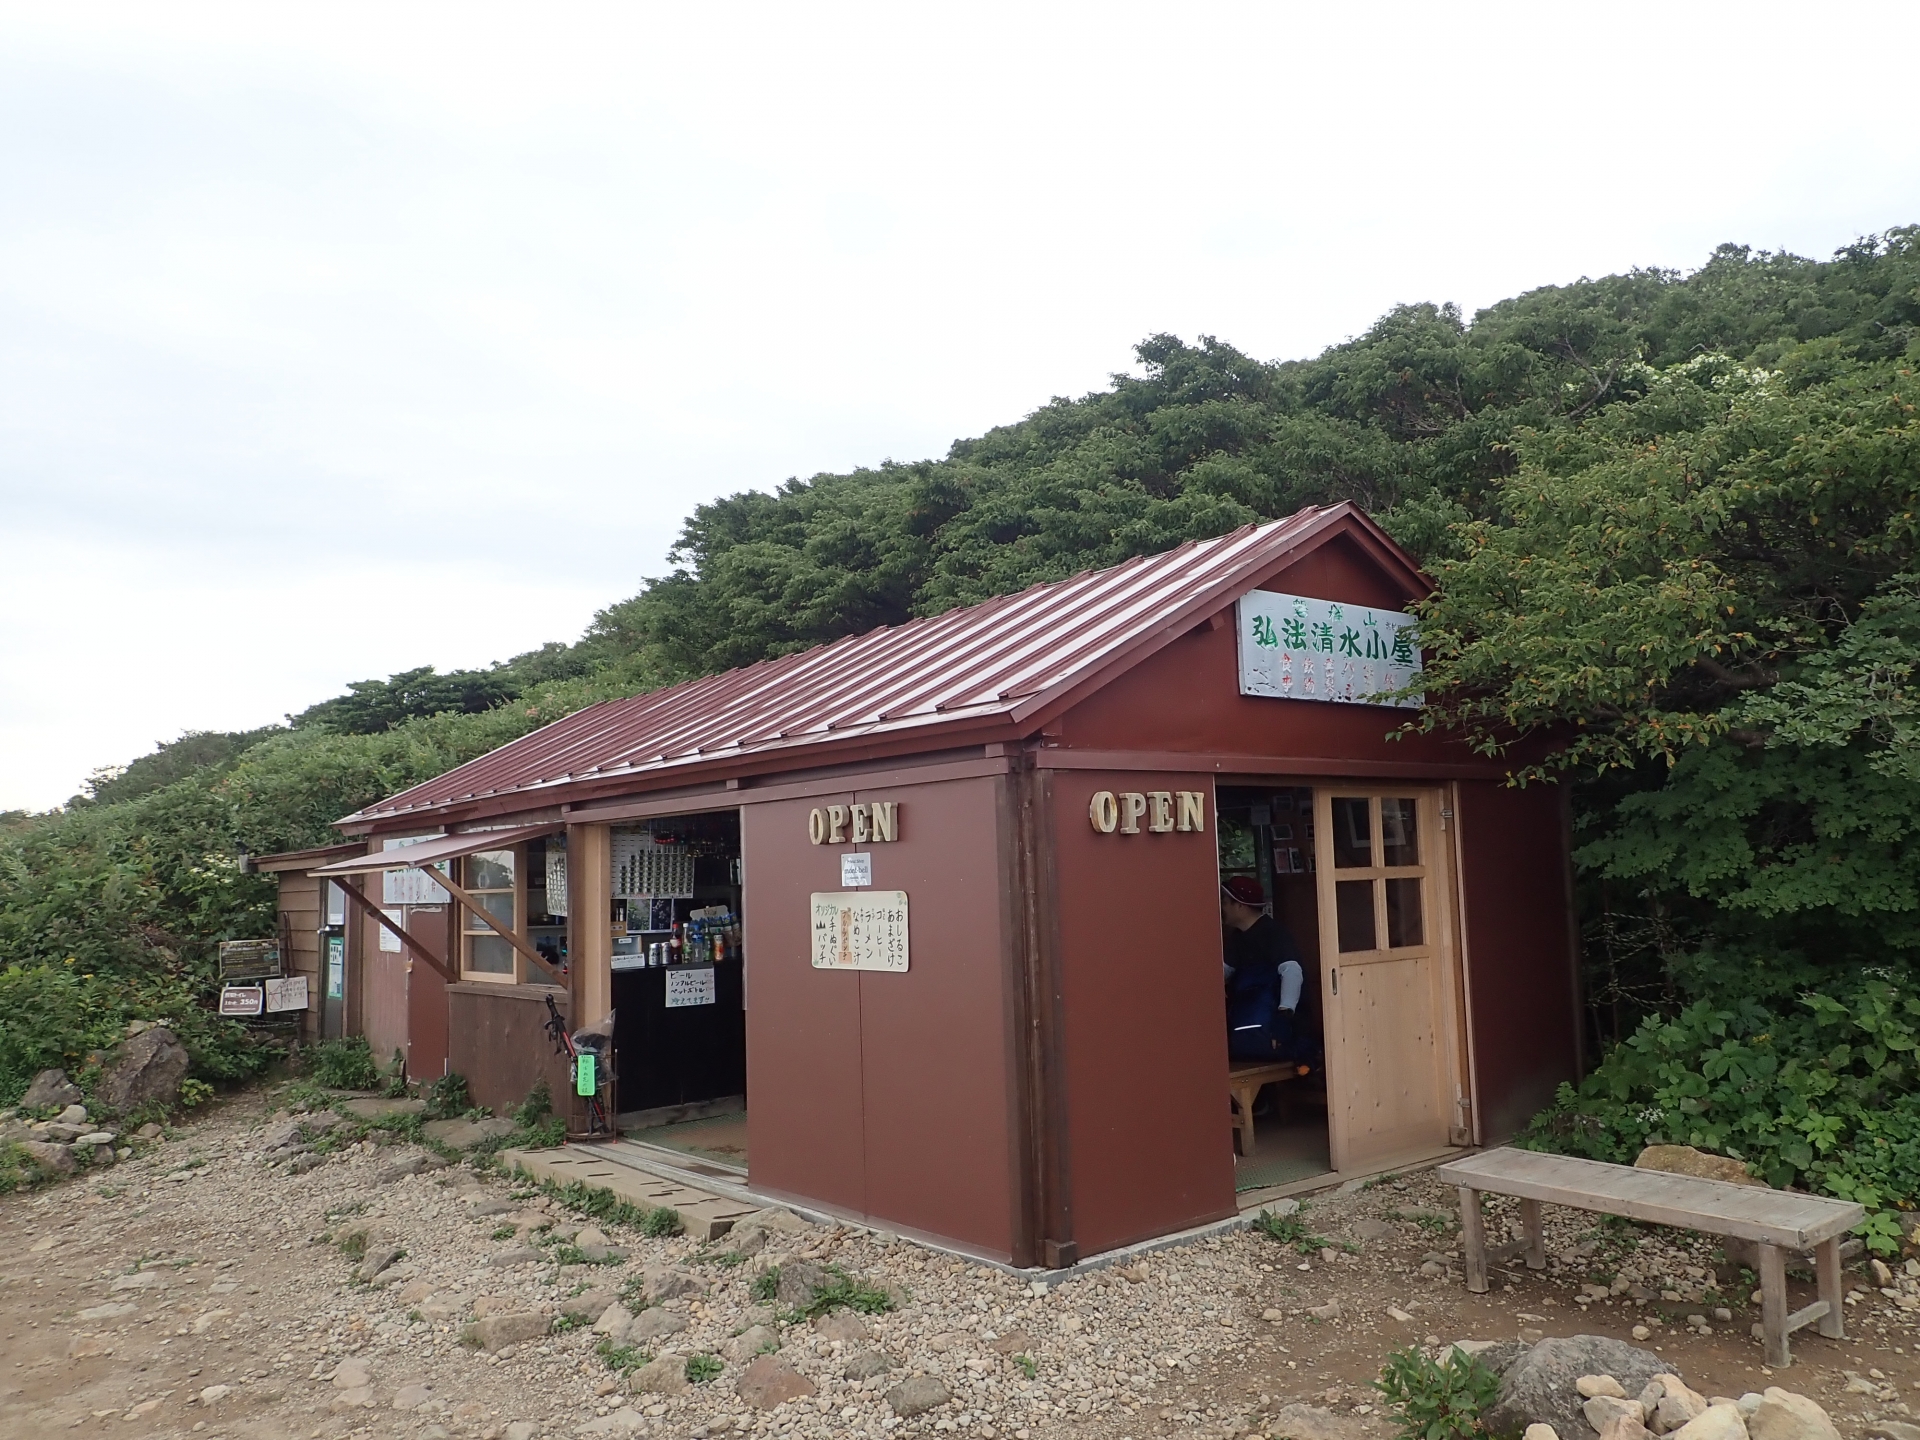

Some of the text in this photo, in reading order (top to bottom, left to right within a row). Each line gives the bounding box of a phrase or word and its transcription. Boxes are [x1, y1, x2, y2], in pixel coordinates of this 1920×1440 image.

[1252, 615, 1413, 664] 弘法清水小屋
[1280, 653, 1293, 693] 食事
[809, 802, 899, 845] OPEN
[1090, 791, 1204, 834] OPEN
[816, 903, 838, 917] オリジナル
[829, 916, 838, 966] 手ぬぐい
[853, 911, 862, 966] なめこ汁
[865, 911, 873, 960] ラーメン
[887, 910, 896, 968] あまざけ
[895, 909, 904, 966] おしるこ
[671, 971, 693, 979] ビール
